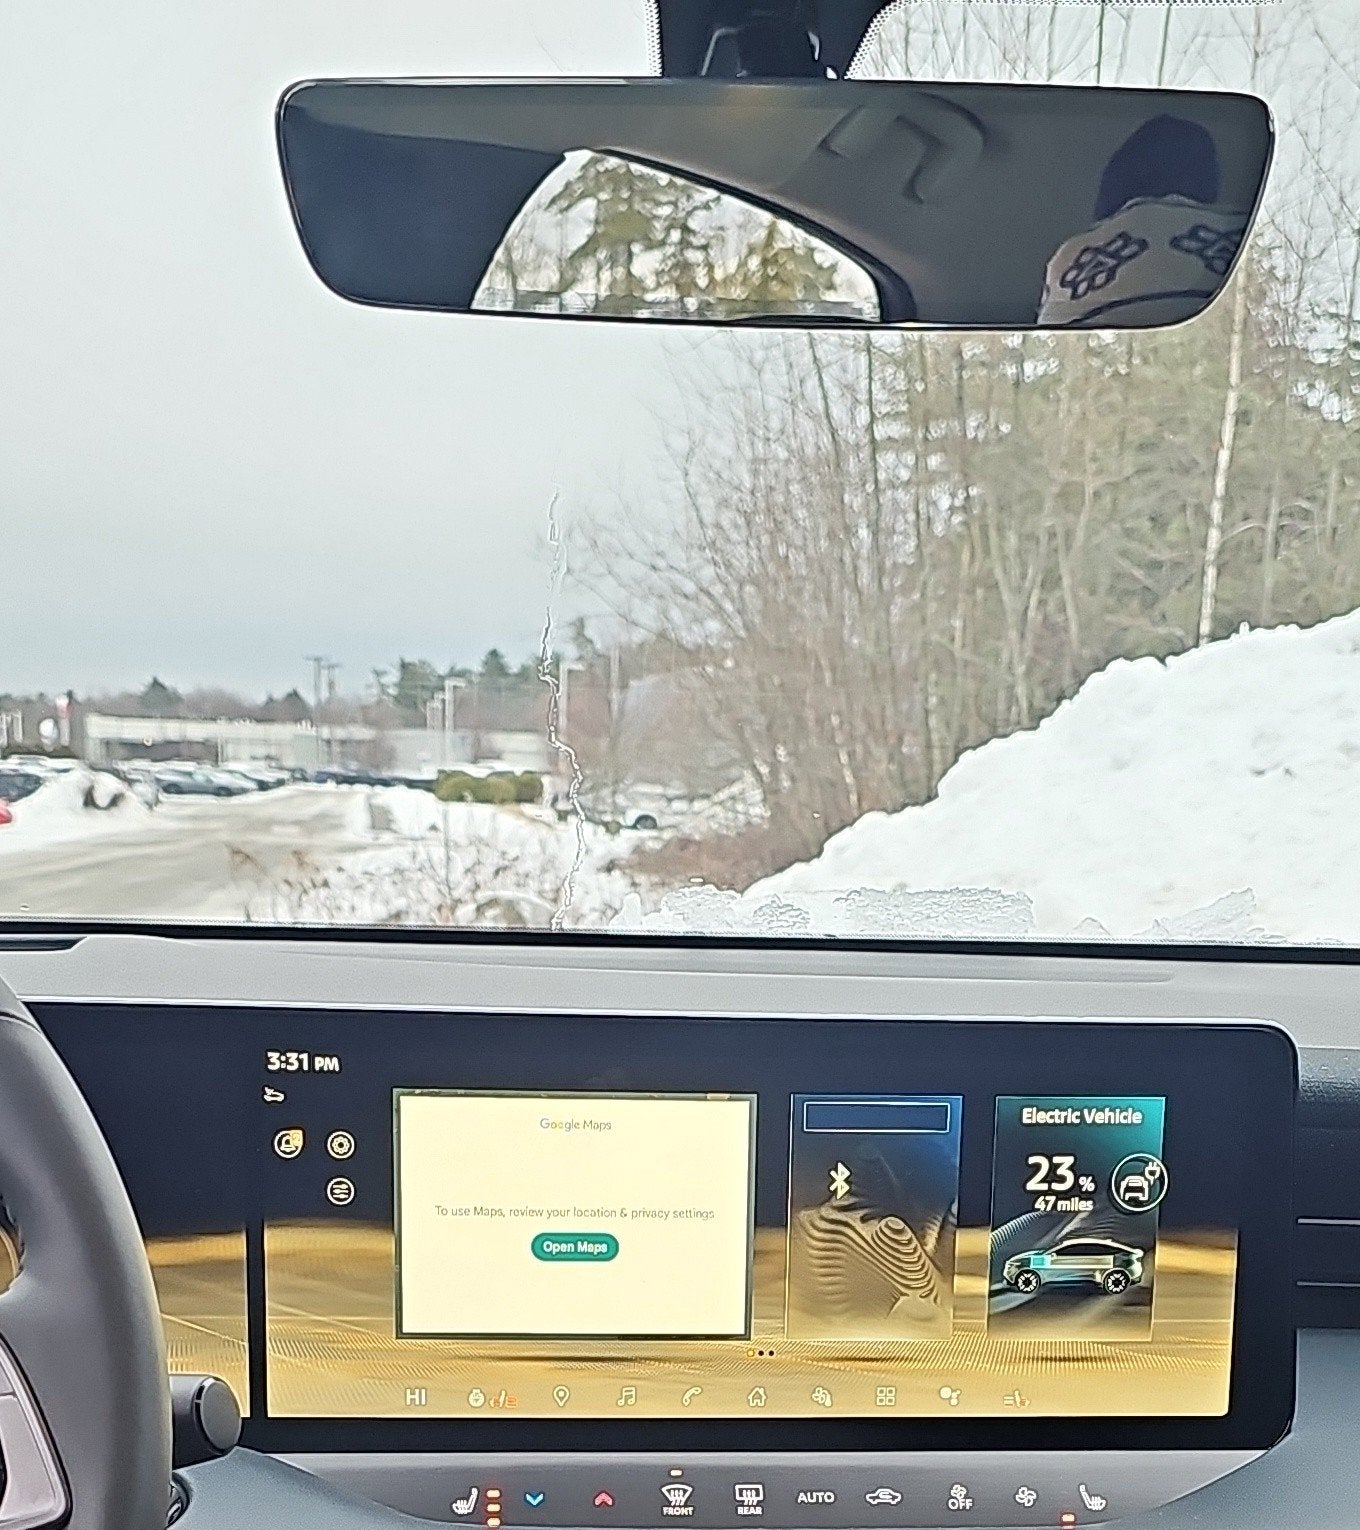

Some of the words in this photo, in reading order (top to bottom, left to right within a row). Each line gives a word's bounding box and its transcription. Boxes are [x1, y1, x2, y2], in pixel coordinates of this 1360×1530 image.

[267, 1052, 309, 1071] 3:31
[315, 1056, 339, 1071] PM
[1022, 1107, 1080, 1124] Electric
[1084, 1107, 1142, 1124] Vehicle
[540, 1118, 580, 1132] Google
[583, 1119, 611, 1132] Maps
[1025, 1155, 1075, 1191] 23
[1079, 1176, 1095, 1191] %
[1034, 1196, 1055, 1211] 47
[1057, 1196, 1093, 1211] miles
[436, 1206, 447, 1216] To
[474, 1207, 505, 1218] Maps,
[509, 1208, 542, 1217] review
[547, 1209, 569, 1219] your
[574, 1208, 616, 1217] location
[620, 1209, 627, 1217] &
[631, 1209, 669, 1220] privacy
[673, 1209, 714, 1220] settings
[543, 1241, 574, 1254] Open
[578, 1241, 607, 1254] Maps
[405, 1389, 427, 1406] HI
[797, 1492, 835, 1504] AUTO
[948, 1498, 973, 1510] OFF
[662, 1506, 694, 1516] FRONT
[737, 1506, 762, 1515] REAR
